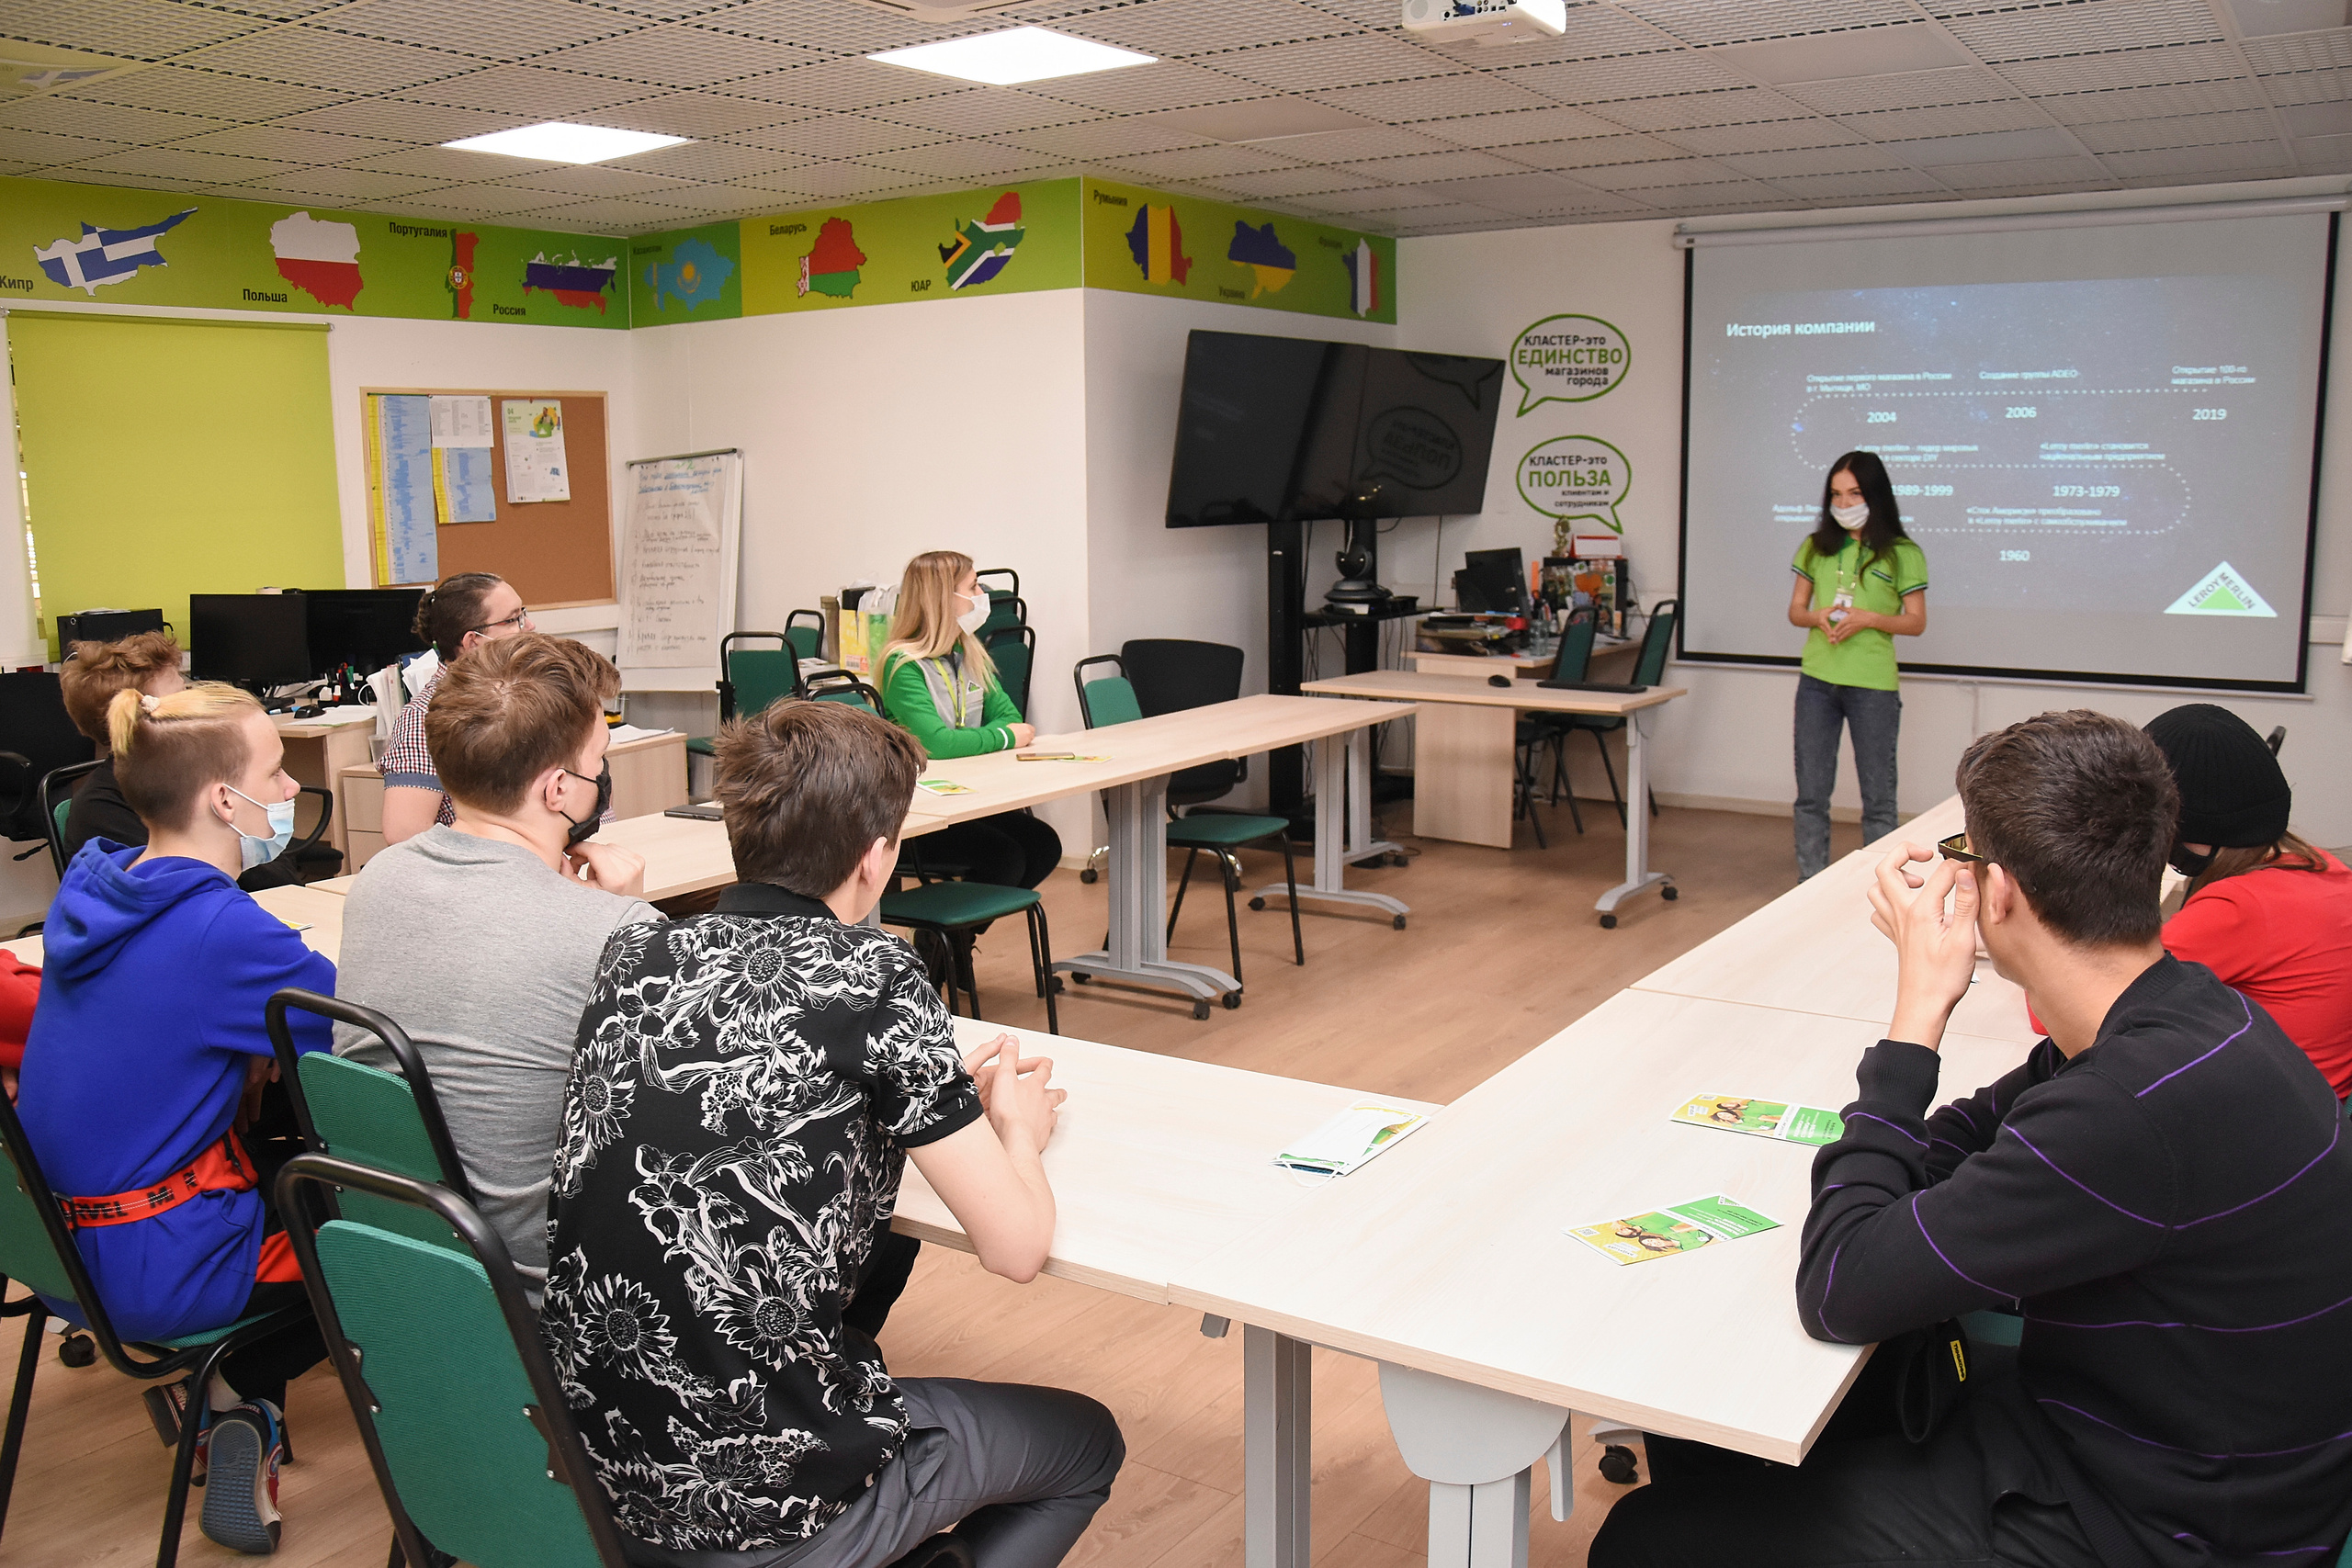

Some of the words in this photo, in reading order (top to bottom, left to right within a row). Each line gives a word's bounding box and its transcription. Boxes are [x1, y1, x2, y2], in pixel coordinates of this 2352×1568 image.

[1093, 189, 1128, 208] Румыния
[389, 221, 448, 239] Португалия
[769, 221, 808, 236] Беларусь
[0, 276, 34, 292] Кипр
[910, 278, 932, 293] ЮАР
[242, 288, 288, 304] Польша
[492, 303, 526, 317] Россия
[1726, 323, 1791, 339] История
[1794, 321, 1875, 335] компании
[1524, 334, 1607, 346] КЛАСТЕР-это
[1518, 348, 1623, 368] ЕДИНСТВО
[1544, 367, 1610, 376] магазинов
[1566, 377, 1610, 388] города
[1867, 411, 1897, 423] 2004
[2005, 406, 2037, 419] 2006
[2192, 408, 2227, 421] 2019
[1529, 455, 1608, 467] КЛАСТЕР-это
[1529, 469, 1611, 487] ПОЛЬЗА
[1891, 484, 1954, 497] 1989-1999
[2052, 485, 2120, 498] 1973-1979
[1999, 550, 2030, 562] 1960
[2188, 578, 2220, 608] LEROY
[2219, 571, 2256, 610] MERLIN
